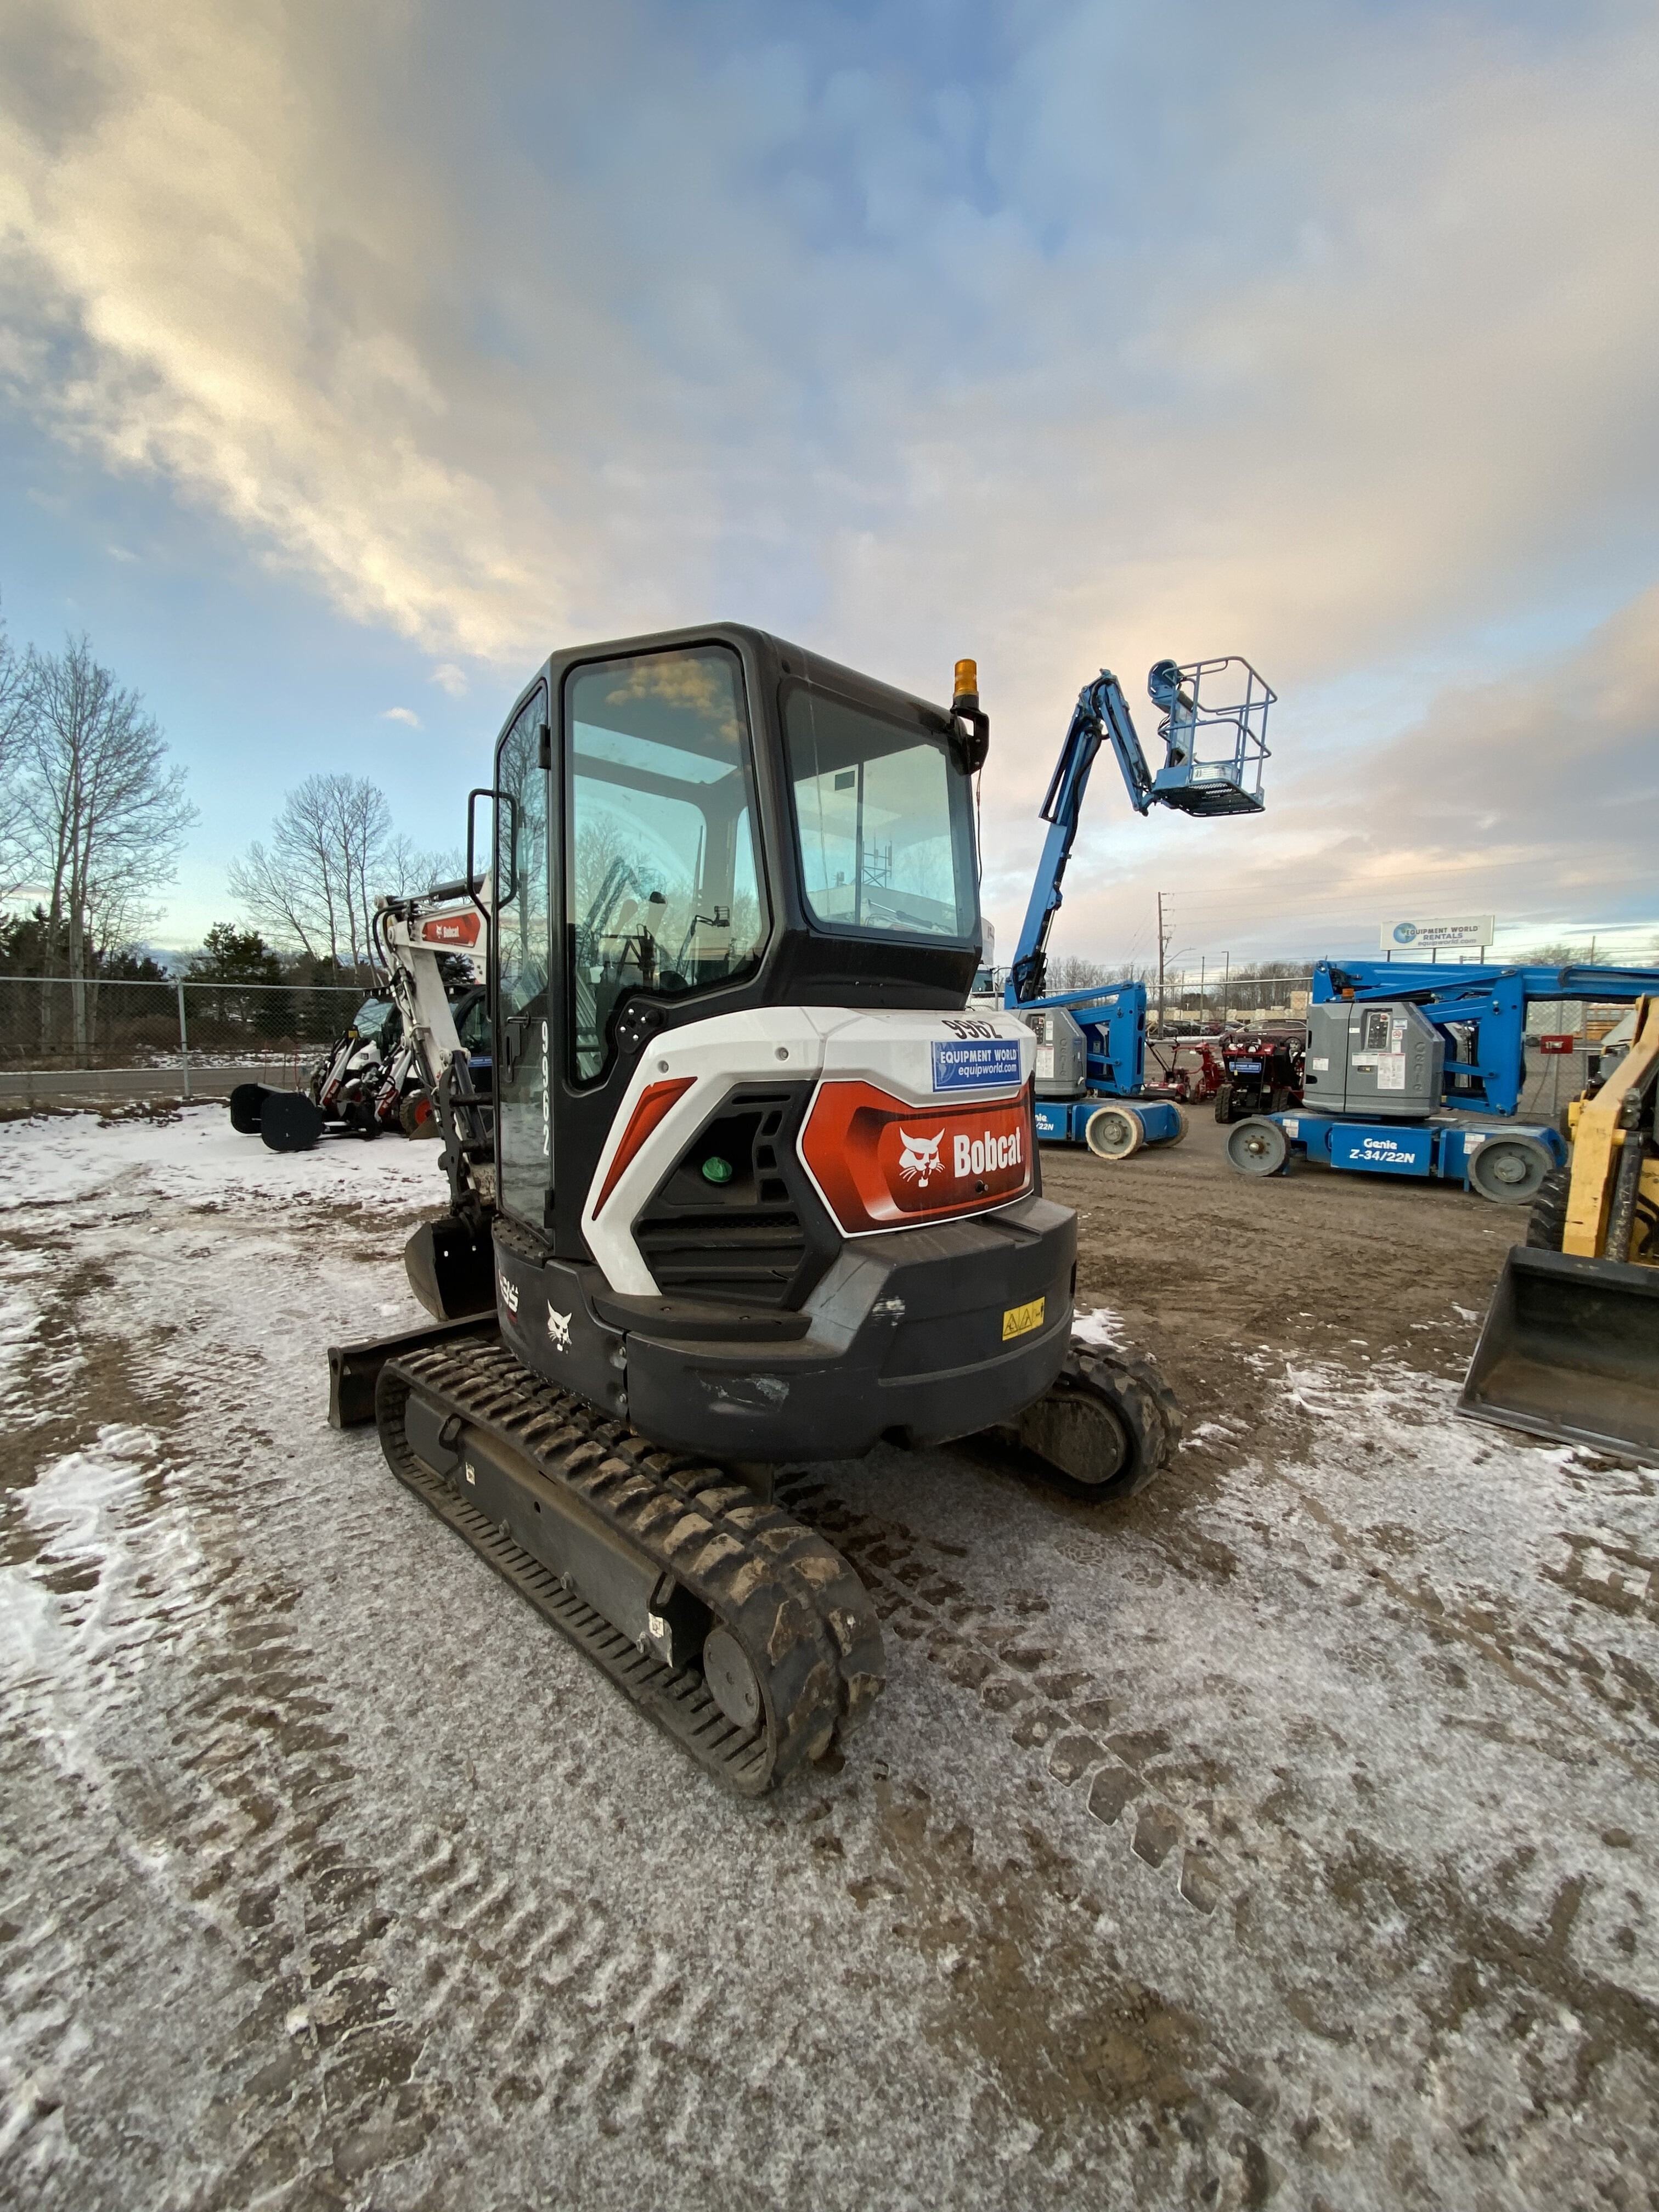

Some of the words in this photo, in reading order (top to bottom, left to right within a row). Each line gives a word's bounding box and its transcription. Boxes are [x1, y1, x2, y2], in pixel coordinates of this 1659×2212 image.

[1406, 927, 1447, 935] EQUIPMENT
[941, 1020, 1003, 1039] 9962
[940, 1049, 992, 1064] EQUIPMENT
[994, 1049, 1017, 1061] WORLD
[958, 1062, 1017, 1078] equipworld.com
[1035, 1113, 1047, 1122] nie
[1363, 1138, 1397, 1150] Genie
[953, 1126, 1022, 1178] Bobcat
[1349, 1149, 1415, 1163] Z-34/22N
